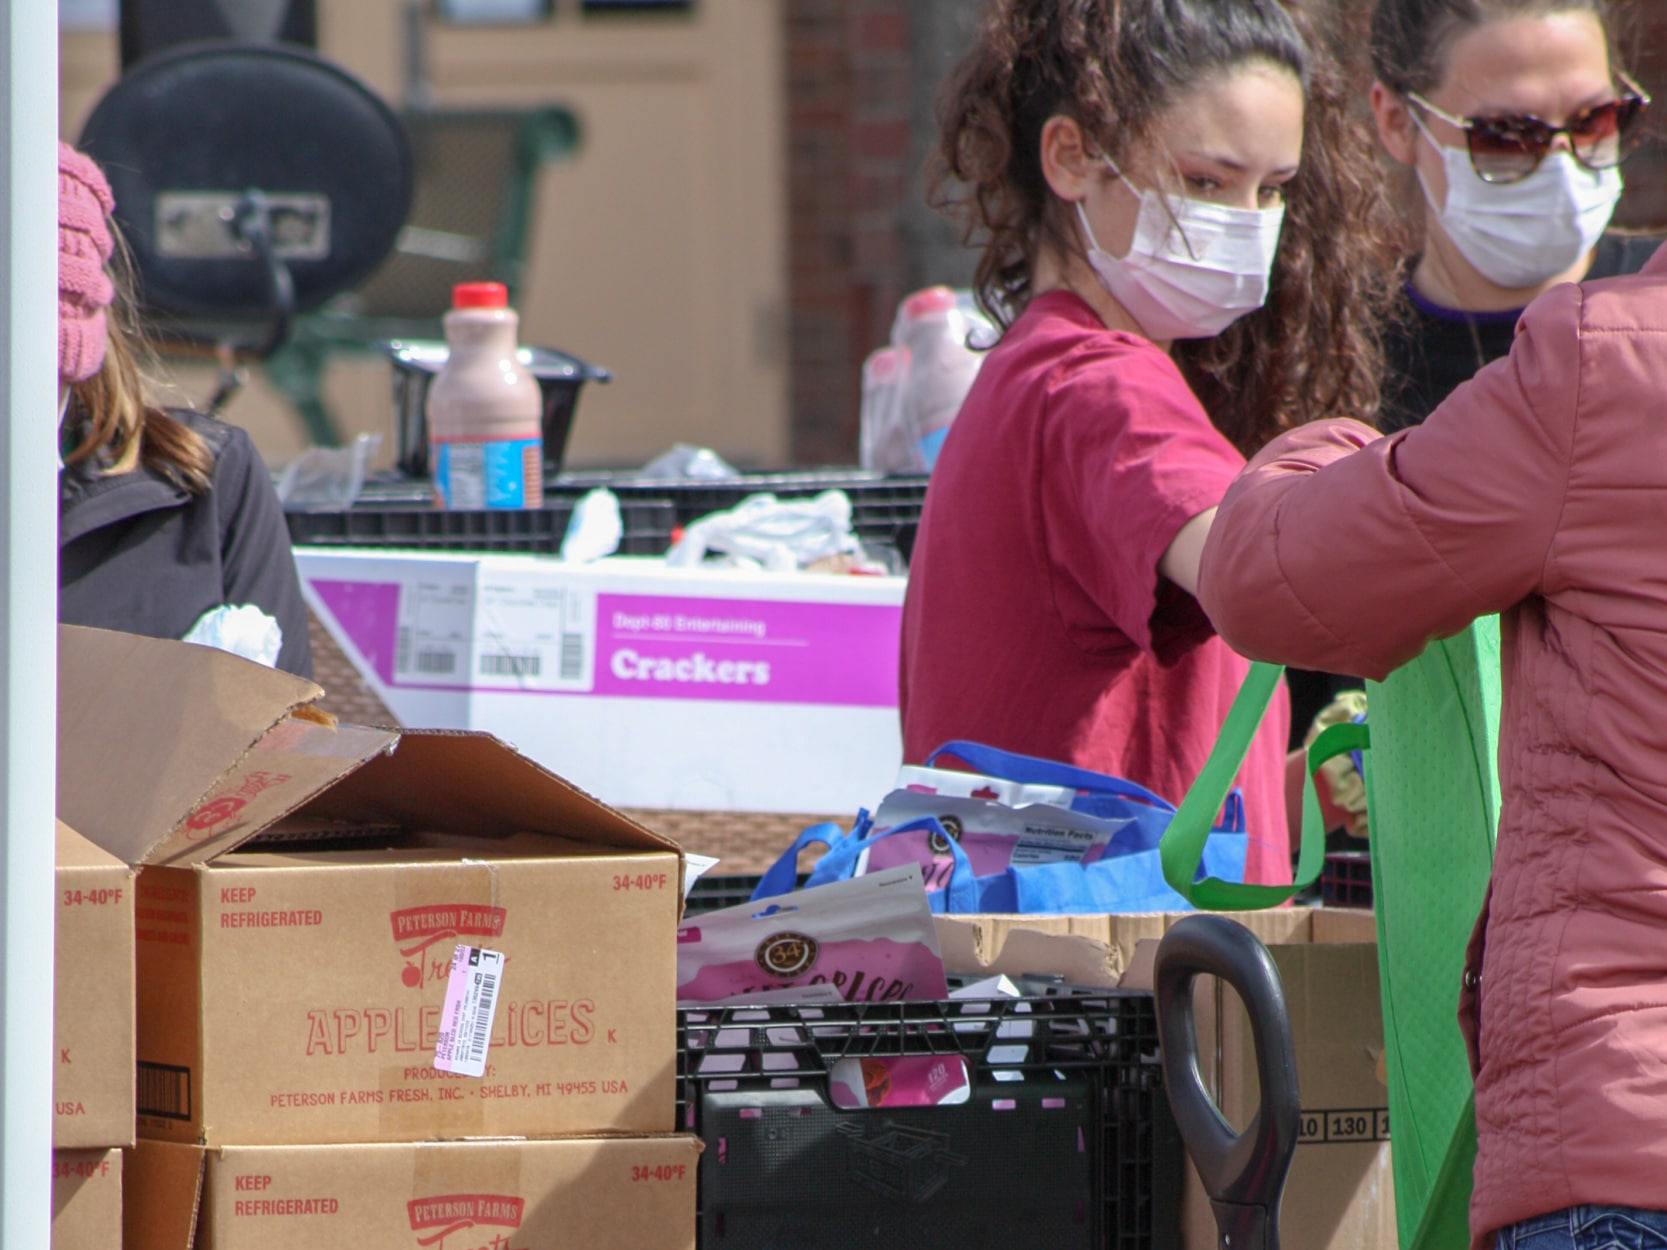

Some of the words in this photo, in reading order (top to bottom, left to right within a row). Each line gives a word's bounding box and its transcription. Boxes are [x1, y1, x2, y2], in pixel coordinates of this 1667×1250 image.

[675, 614, 766, 638] Entertaining
[611, 648, 771, 685] Crackers
[1068, 829, 1094, 840] Facts
[220, 886, 256, 904] KEEP
[220, 908, 323, 928] REFRIGERATED
[397, 911, 457, 934] PETERSON
[460, 910, 499, 929] FARMS
[481, 952, 496, 962] 1
[306, 1005, 440, 1056] APPLE
[607, 1028, 617, 1043] K
[60, 1047, 72, 1065] K
[269, 1092, 335, 1108] PETERSON
[340, 1089, 384, 1104] FARMS
[438, 1086, 464, 1101] INC.
[535, 1082, 551, 1097] MI
[556, 1080, 596, 1095] 49455
[601, 1079, 628, 1094] USA
[55, 1102, 85, 1116] USA
[1300, 1118, 1319, 1136] 10
[1332, 1116, 1367, 1136] 130
[234, 1174, 272, 1192] KEEP
[234, 1197, 339, 1216] REFRIGERATED
[414, 1200, 474, 1223] PETERSON
[478, 1200, 518, 1220] FARMS
